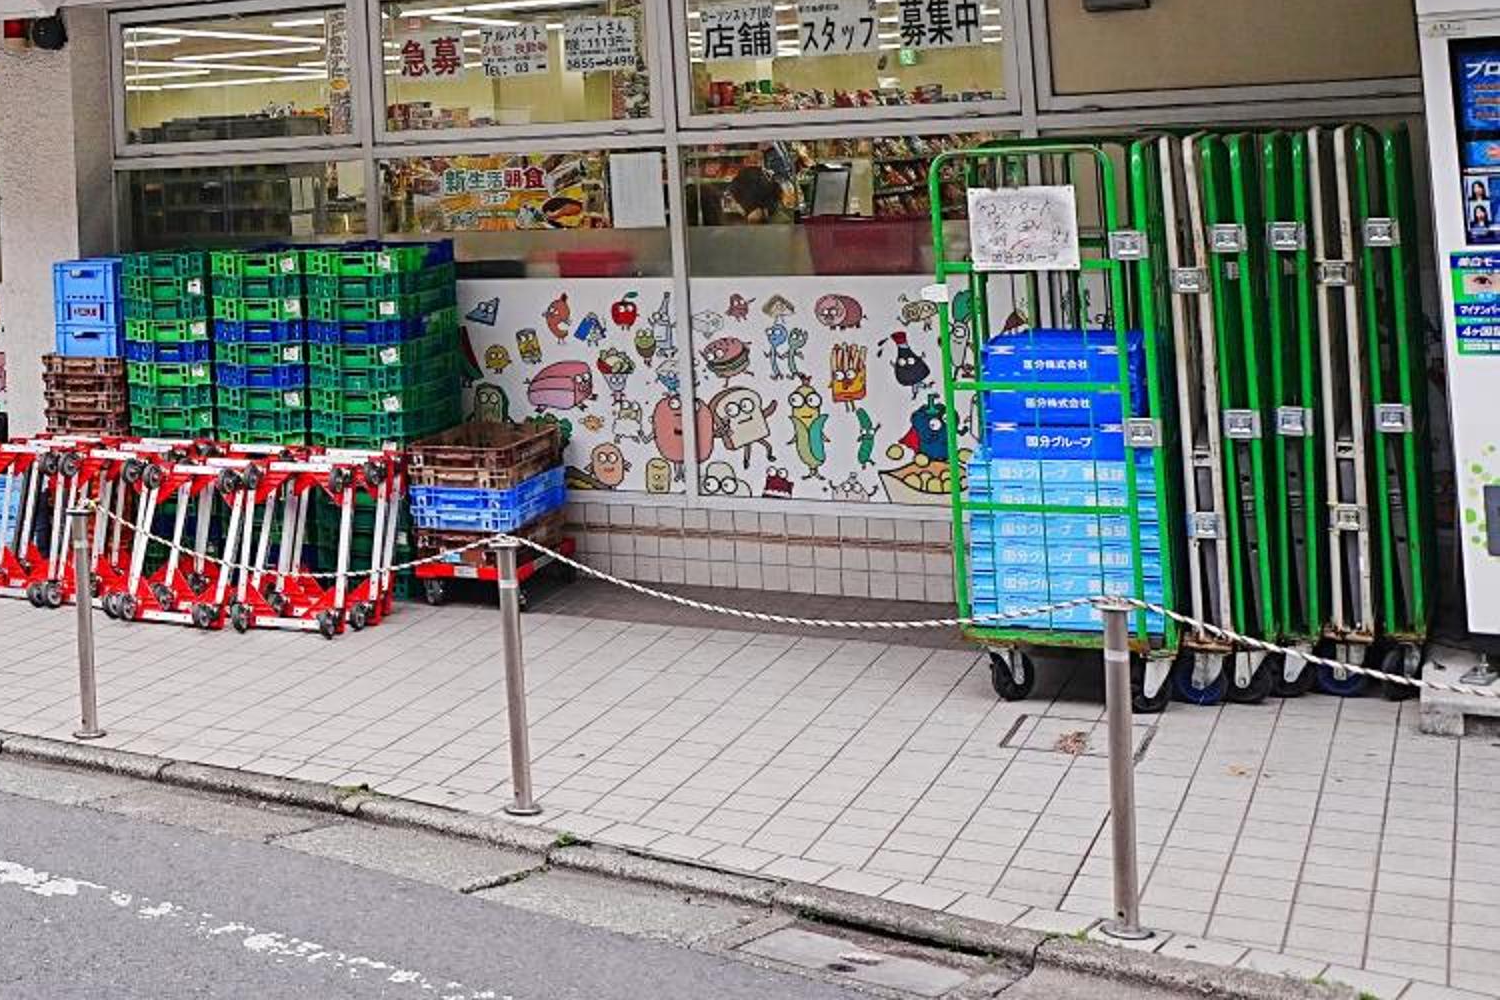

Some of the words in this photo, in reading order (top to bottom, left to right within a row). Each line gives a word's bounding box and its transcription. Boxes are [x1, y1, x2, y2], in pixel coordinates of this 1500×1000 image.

[482, 28, 542, 44] アルバイト
[704, 21, 772, 59] 店舗
[802, 16, 875, 52] スタッフ
[400, 36, 462, 78] 急募
[444, 166, 545, 193] 新生活朝食
[1022, 359, 1088, 370] 国分株式会社
[1025, 435, 1093, 448] 国分グループ
